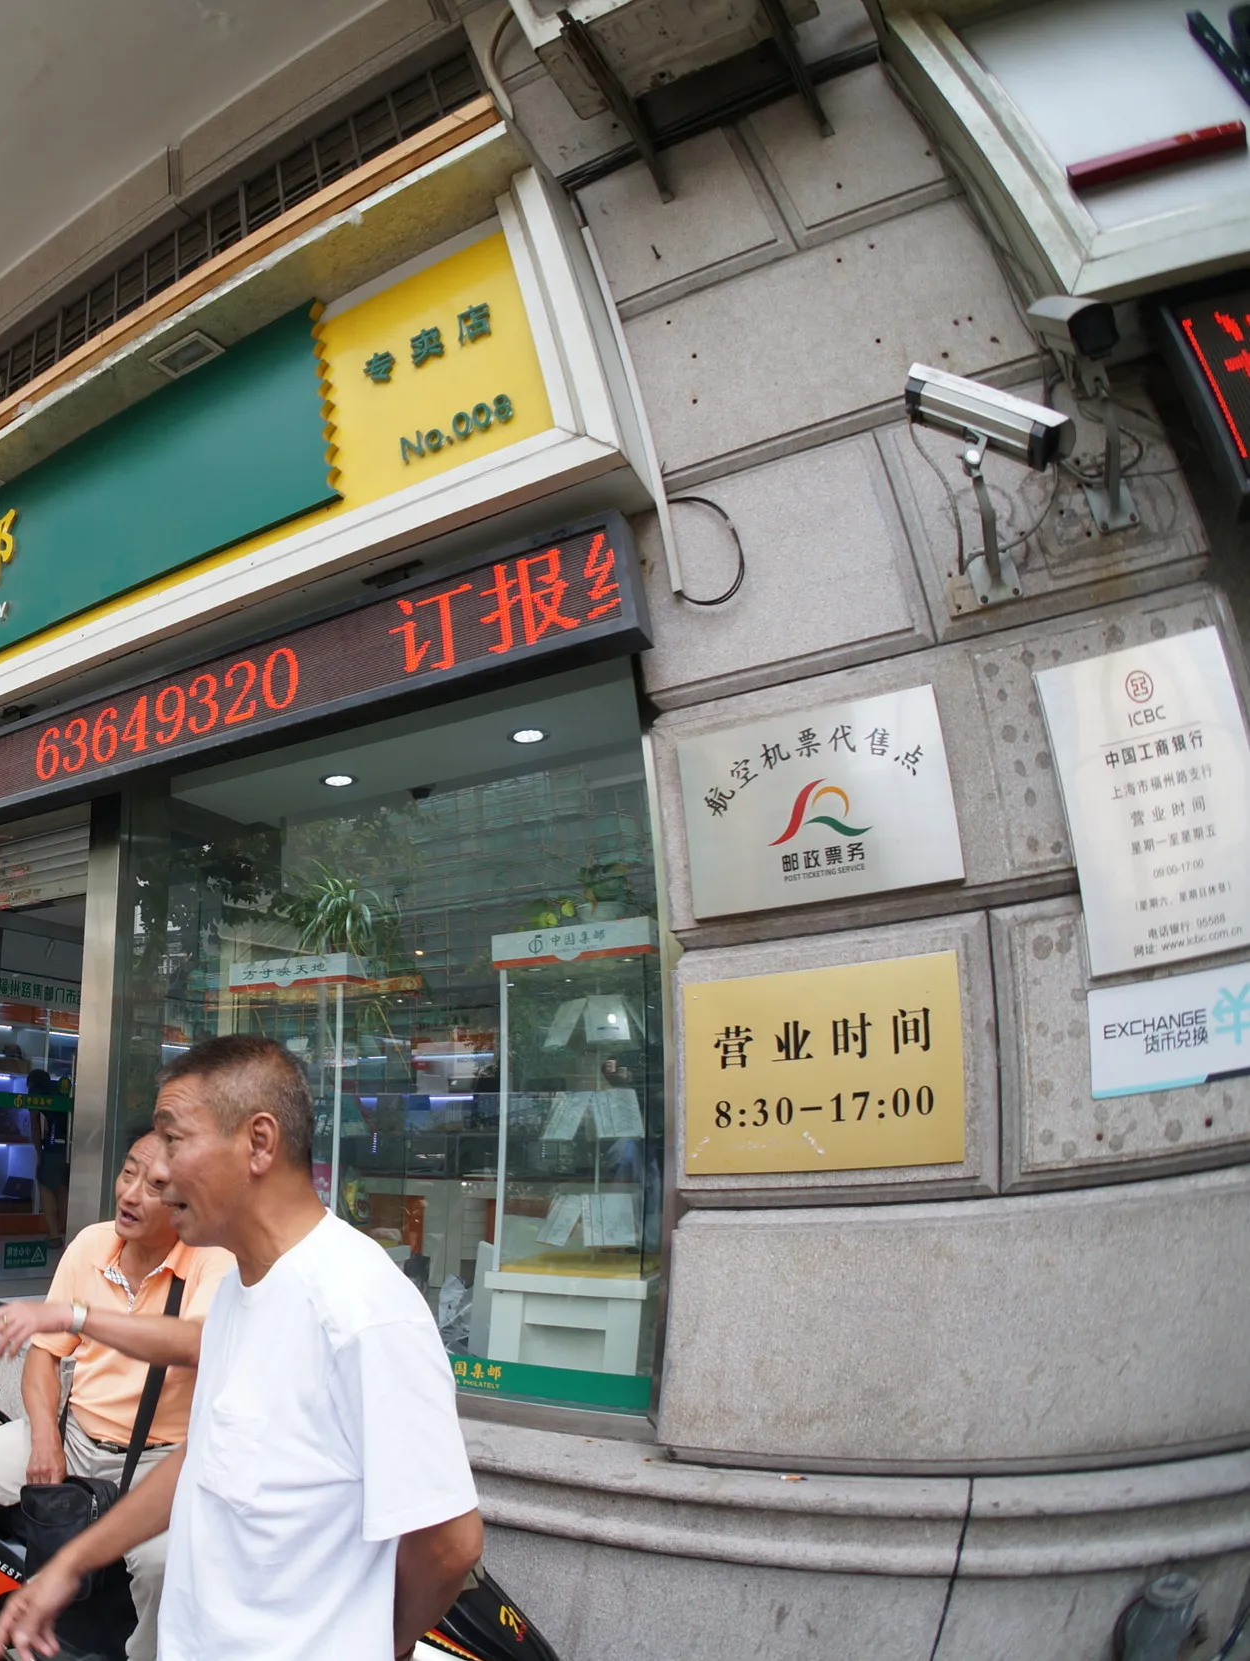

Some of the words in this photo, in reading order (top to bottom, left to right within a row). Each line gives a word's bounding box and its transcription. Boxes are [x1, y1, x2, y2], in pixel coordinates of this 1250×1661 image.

[363, 302, 492, 383] 专卖店
[399, 393, 515, 464] No.008
[35, 647, 301, 782] 63649320
[1127, 705, 1167, 728] ICBC
[1105, 729, 1204, 769] 中国工商银行
[703, 724, 924, 818] 航空机票代售点
[1111, 763, 1213, 800] 上海市福州路支行
[1130, 796, 1207, 827] 营业时间
[1131, 824, 1217, 855] 星期一至星期五
[781, 841, 866, 873] 邮政票务
[784, 872, 801, 883] POST
[802, 866, 837, 881] TICKETING
[837, 863, 866, 876] SERVICE
[1153, 859, 1205, 879] 09:00-17:00
[1196, 913, 1226, 928] 95588
[551, 929, 606, 946] 中国集邮
[712, 1005, 932, 1070] 营业时间
[1103, 1008, 1207, 1040] EXCHANGE
[1143, 1026, 1209, 1055] 货币兑换
